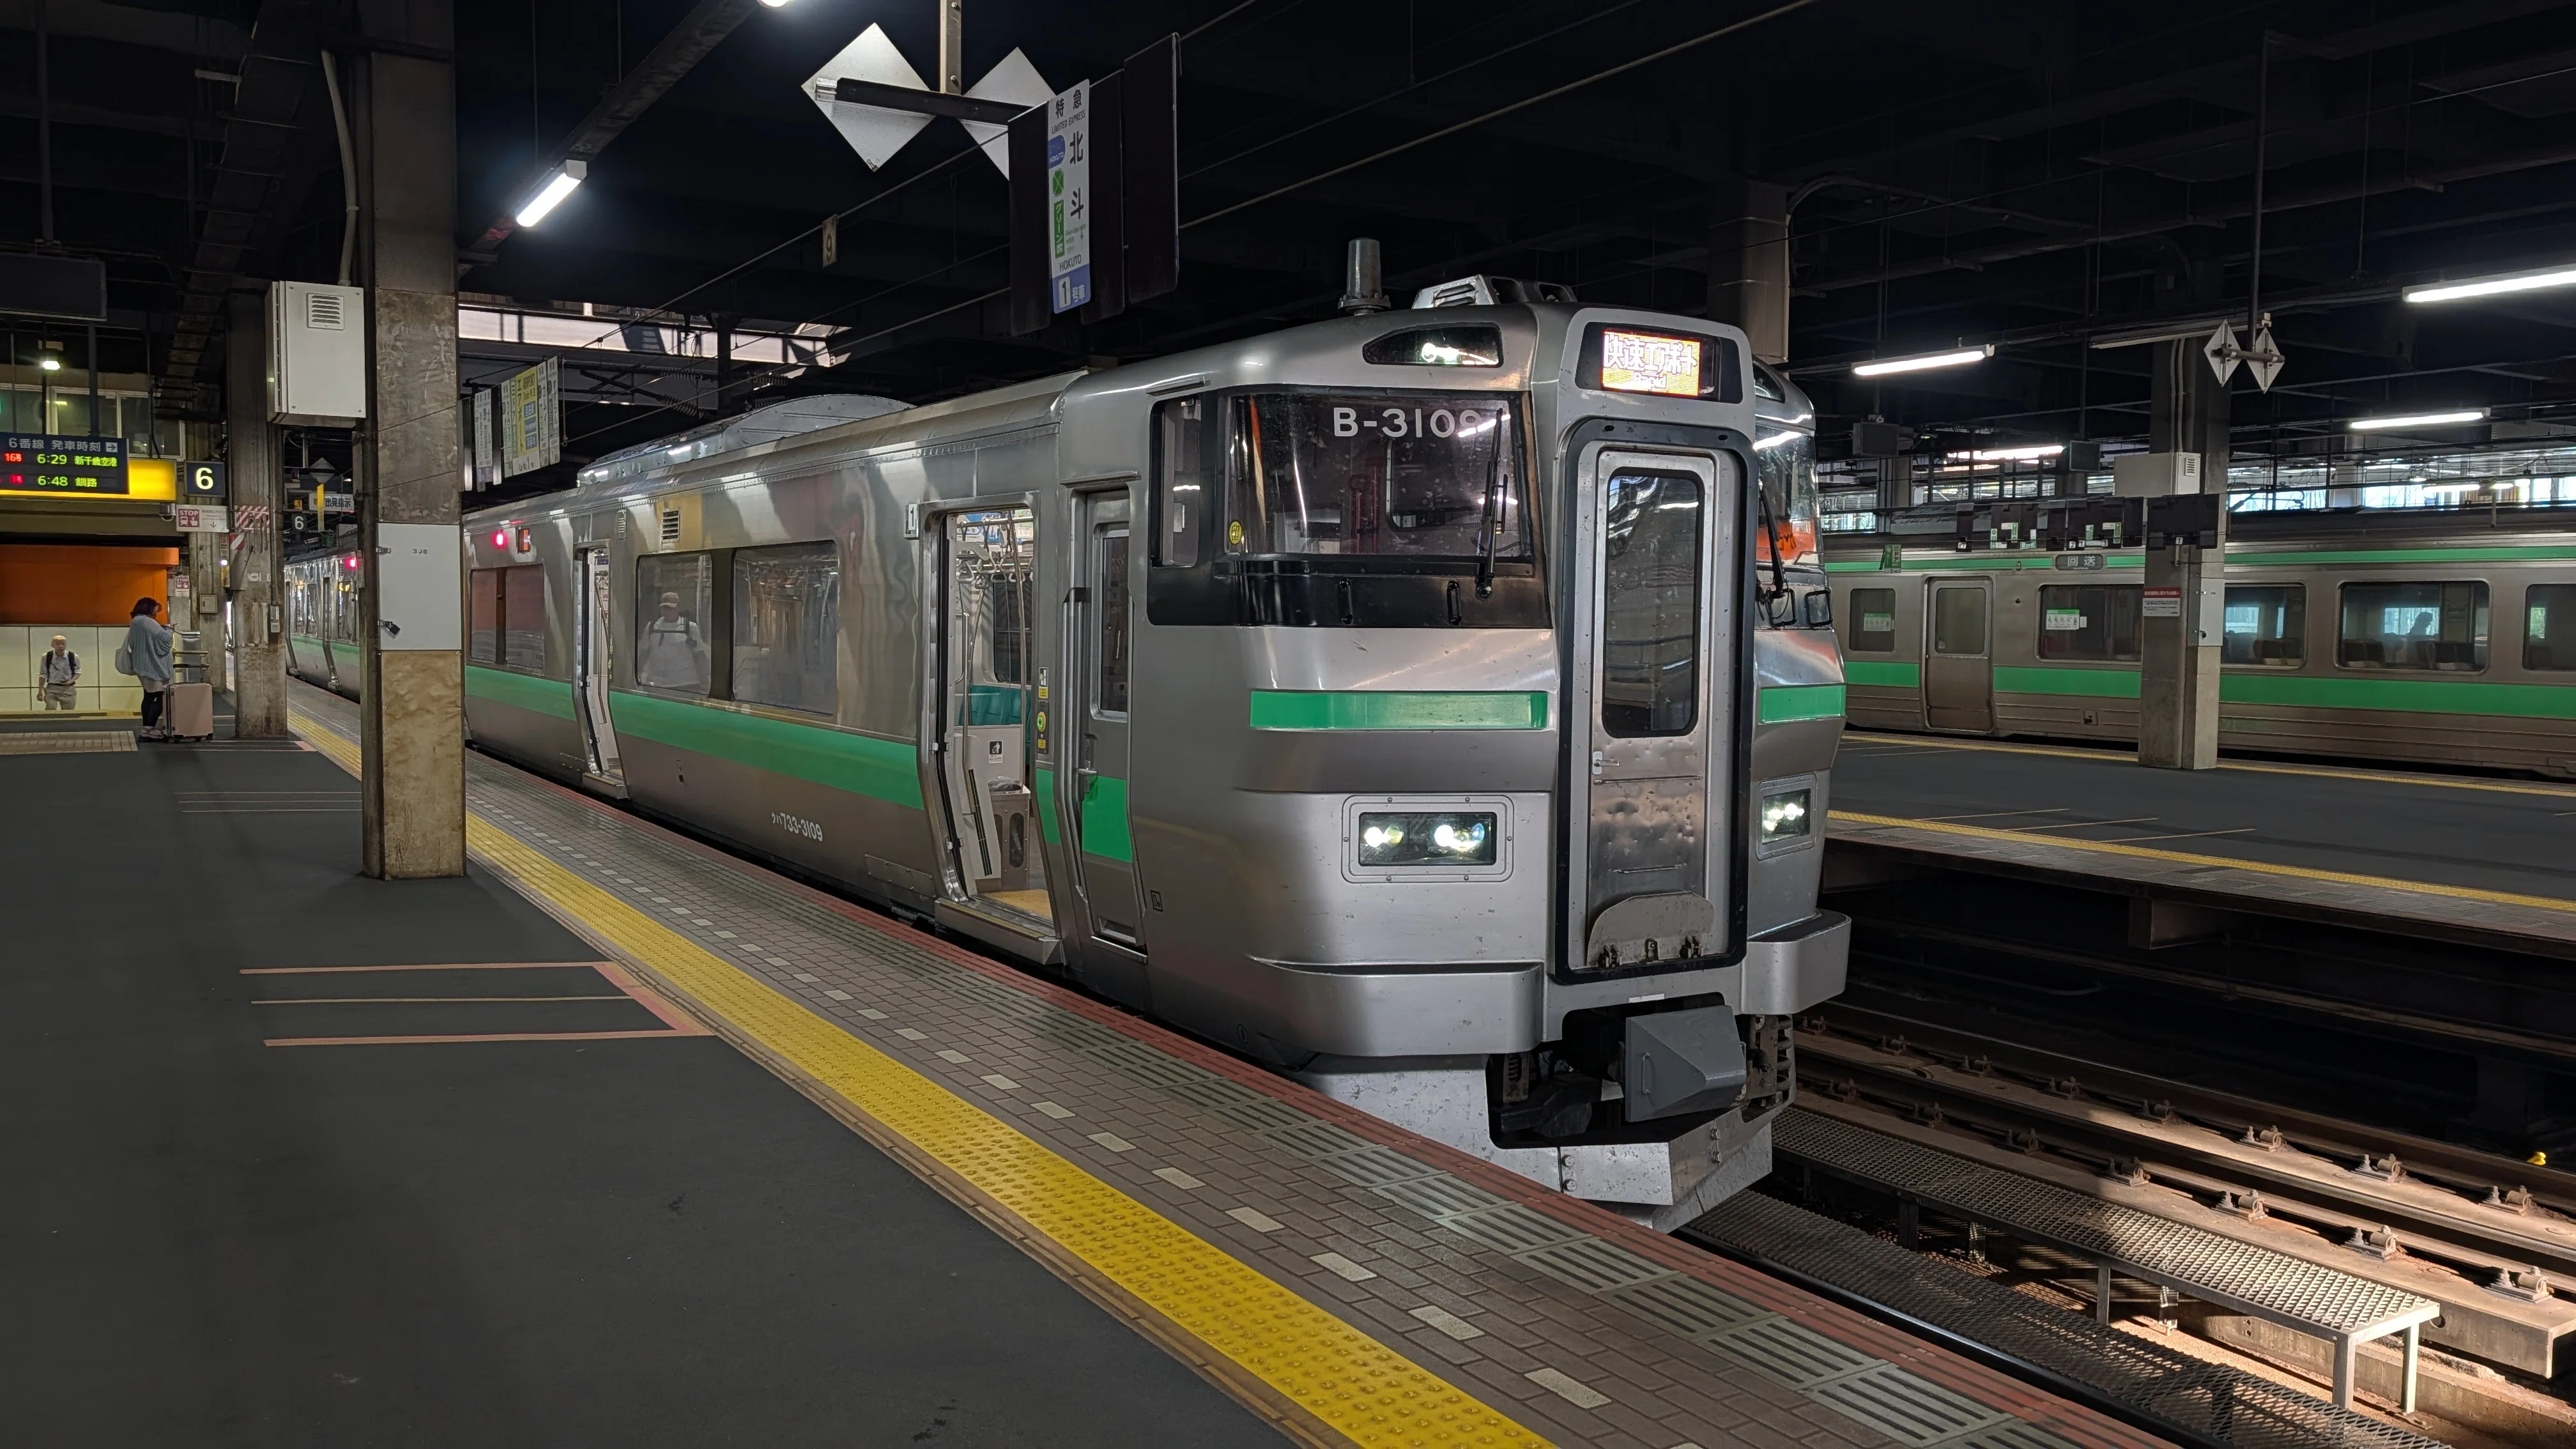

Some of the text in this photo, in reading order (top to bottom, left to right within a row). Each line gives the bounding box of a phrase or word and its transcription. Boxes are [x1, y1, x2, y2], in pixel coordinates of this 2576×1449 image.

[1055, 89, 1082, 119] 特急
[1052, 109, 1085, 134] LIMITED EXPRESS
[1070, 130, 1084, 219] 北斗
[1059, 254, 1082, 272] HOKUTO
[9, 438, 101, 452] 6番線 発車時刻
[37, 454, 66, 464] 6:29
[38, 476, 68, 486] 6:48
[195, 467, 213, 489] 6
[295, 516, 304, 530] 6
[2067, 555, 2096, 567] 回送
